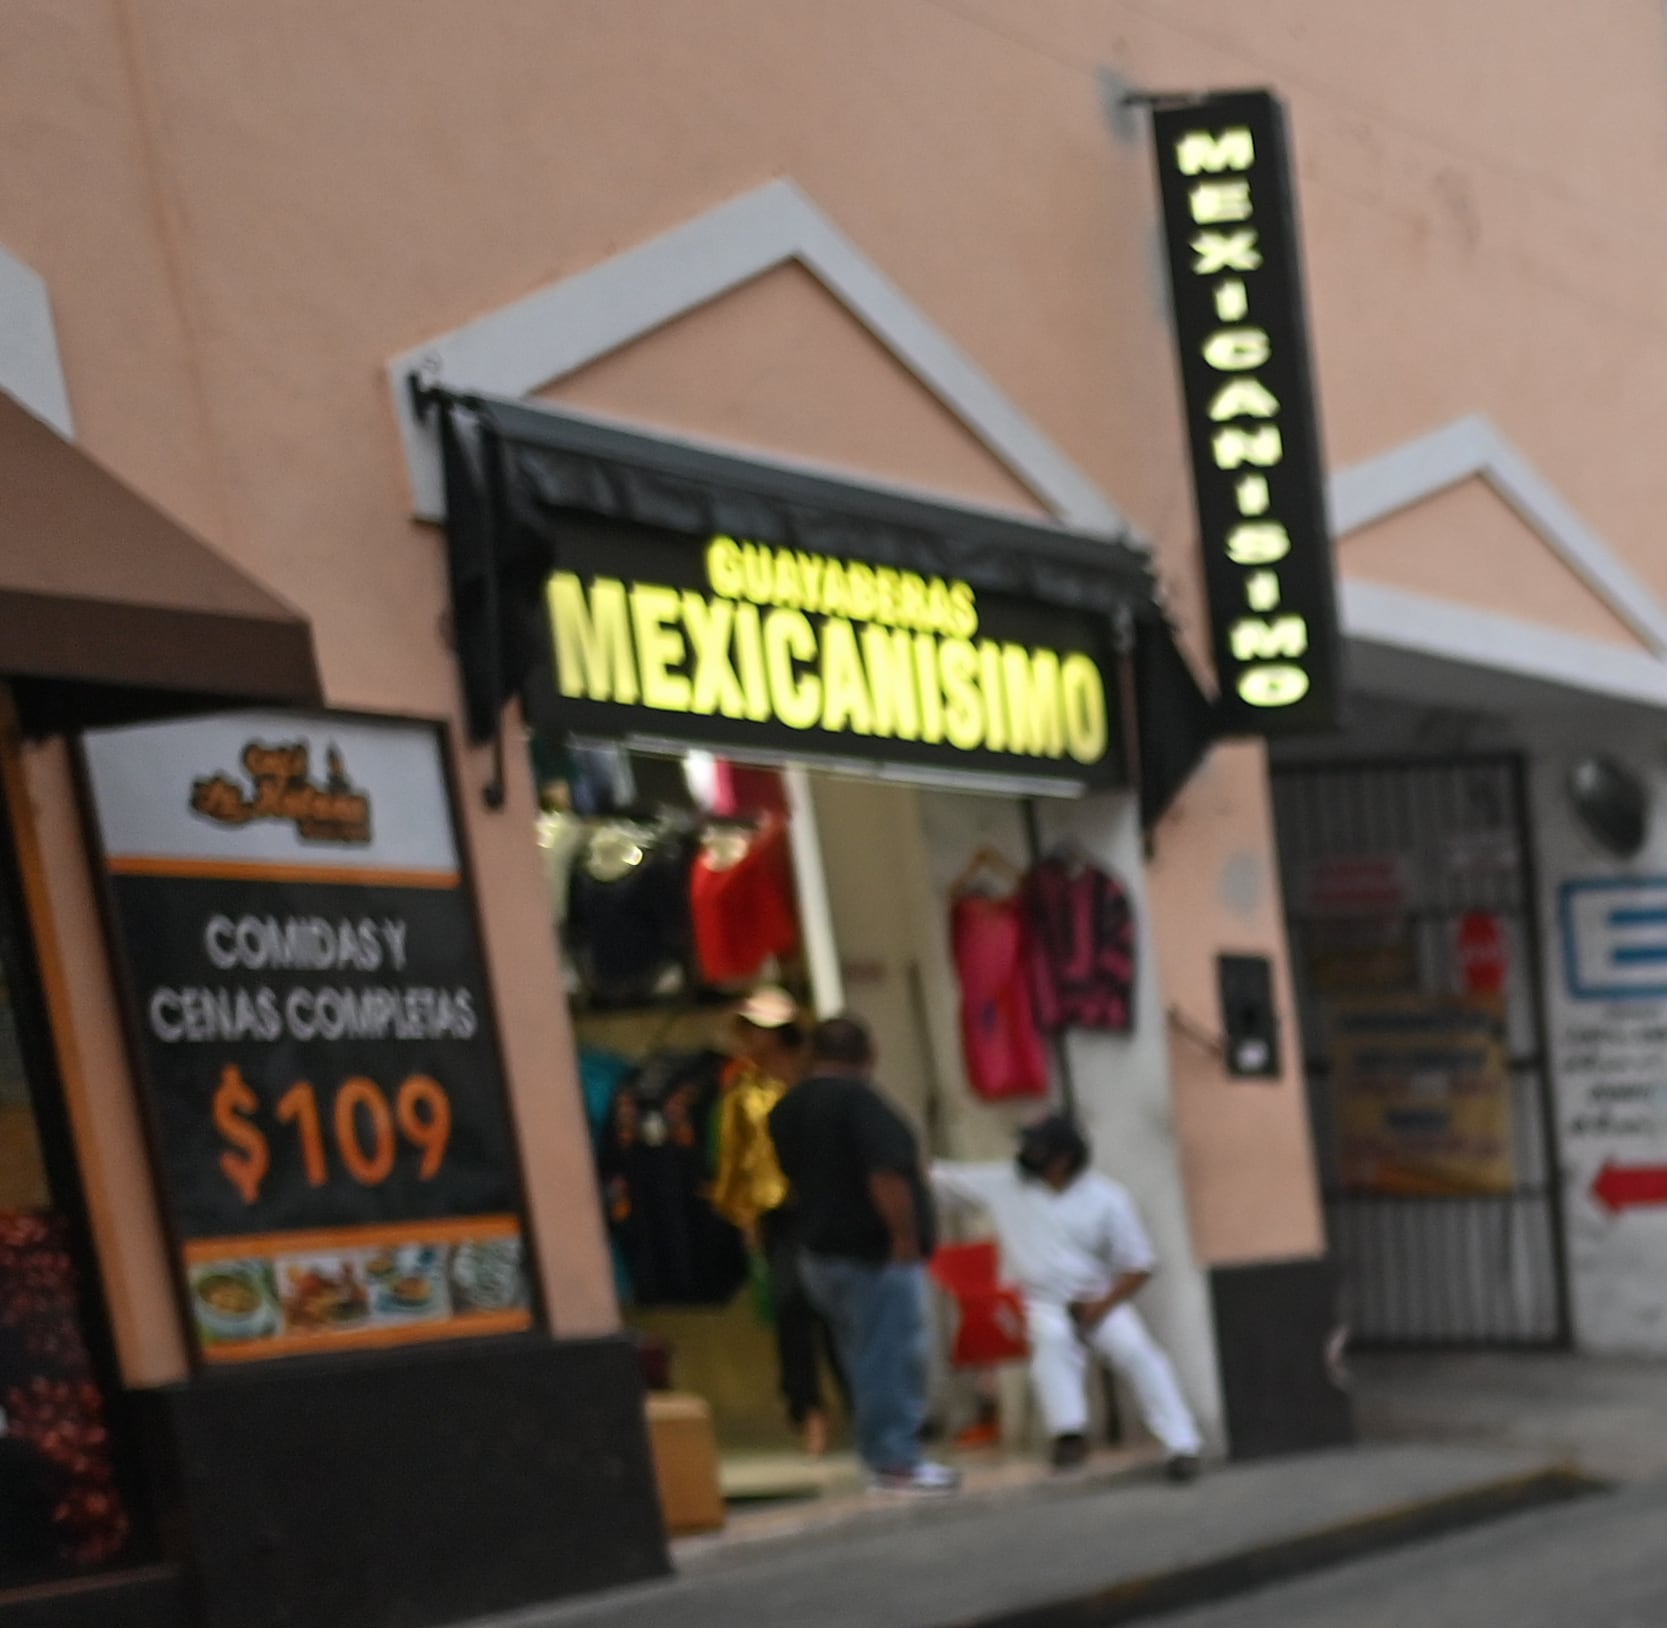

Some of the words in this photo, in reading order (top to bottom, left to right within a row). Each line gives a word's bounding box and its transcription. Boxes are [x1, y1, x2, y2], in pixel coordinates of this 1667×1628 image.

[1176, 128, 1309, 707] MEXICANISIMO
[706, 537, 978, 639] GUAYABERAS
[546, 569, 1108, 765] MEXICANISIMO
[205, 914, 381, 971] COMIDAS
[381, 921, 406, 967] Y
[149, 989, 278, 1042] CENAS
[288, 986, 478, 1042] COMPLETAS
[213, 1066, 451, 1202] $109
